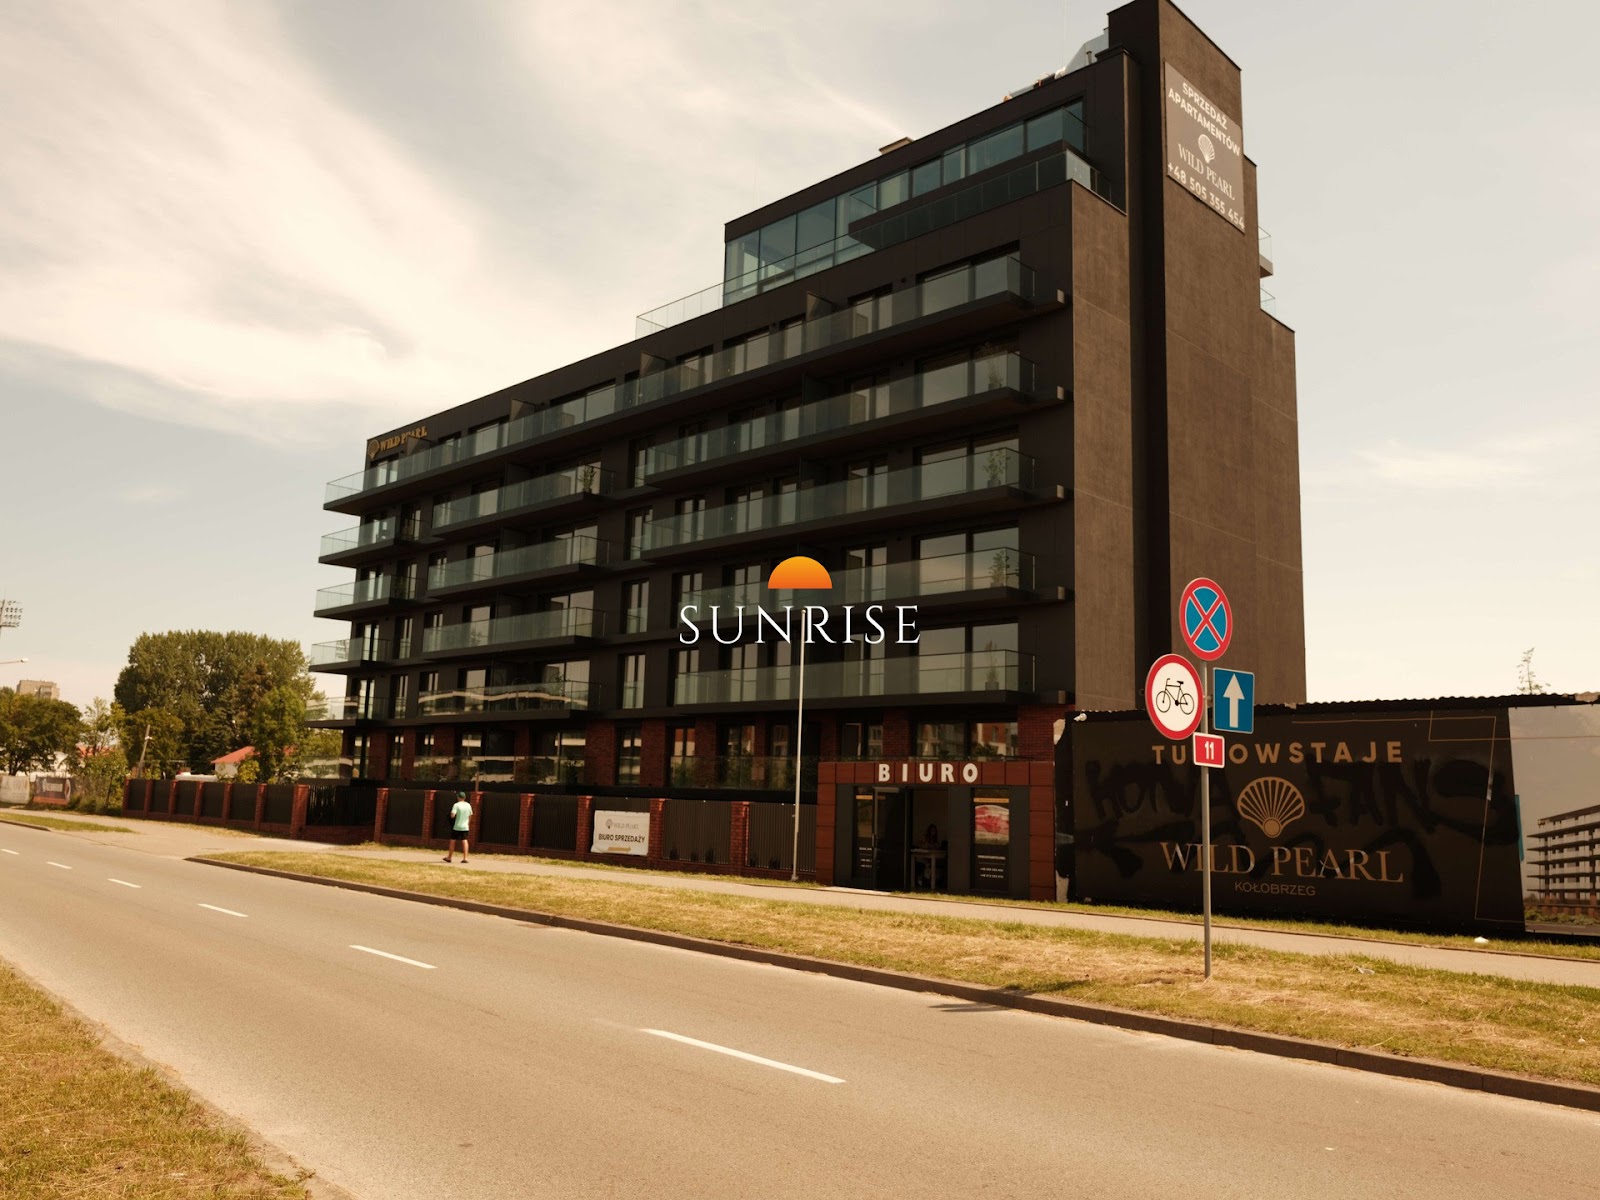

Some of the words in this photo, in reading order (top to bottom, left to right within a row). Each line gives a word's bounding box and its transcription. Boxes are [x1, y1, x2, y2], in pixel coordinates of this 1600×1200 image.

[1182, 82, 1228, 130] SPRZEDAŻ
[1168, 88, 1241, 157] APARTAMENTÓW
[1178, 143, 1204, 175] WILD
[1206, 165, 1235, 200] PEARL
[1168, 162, 1186, 184] +48
[1189, 177, 1207, 200] 505
[1209, 192, 1226, 215] 355
[1228, 209, 1245, 230] 454
[1151, 744, 1186, 765] TU
[1228, 741, 1403, 765] OWSTAJE
[1204, 740, 1215, 760] 11
[878, 763, 979, 783] BIURO
[598, 833, 614, 841] BIURO
[614, 834, 646, 843] SPRZEDAŻY
[1159, 842, 1256, 874] WILD
[1270, 846, 1404, 883] PEARL
[1234, 881, 1316, 896] KOŁOBRZEG
